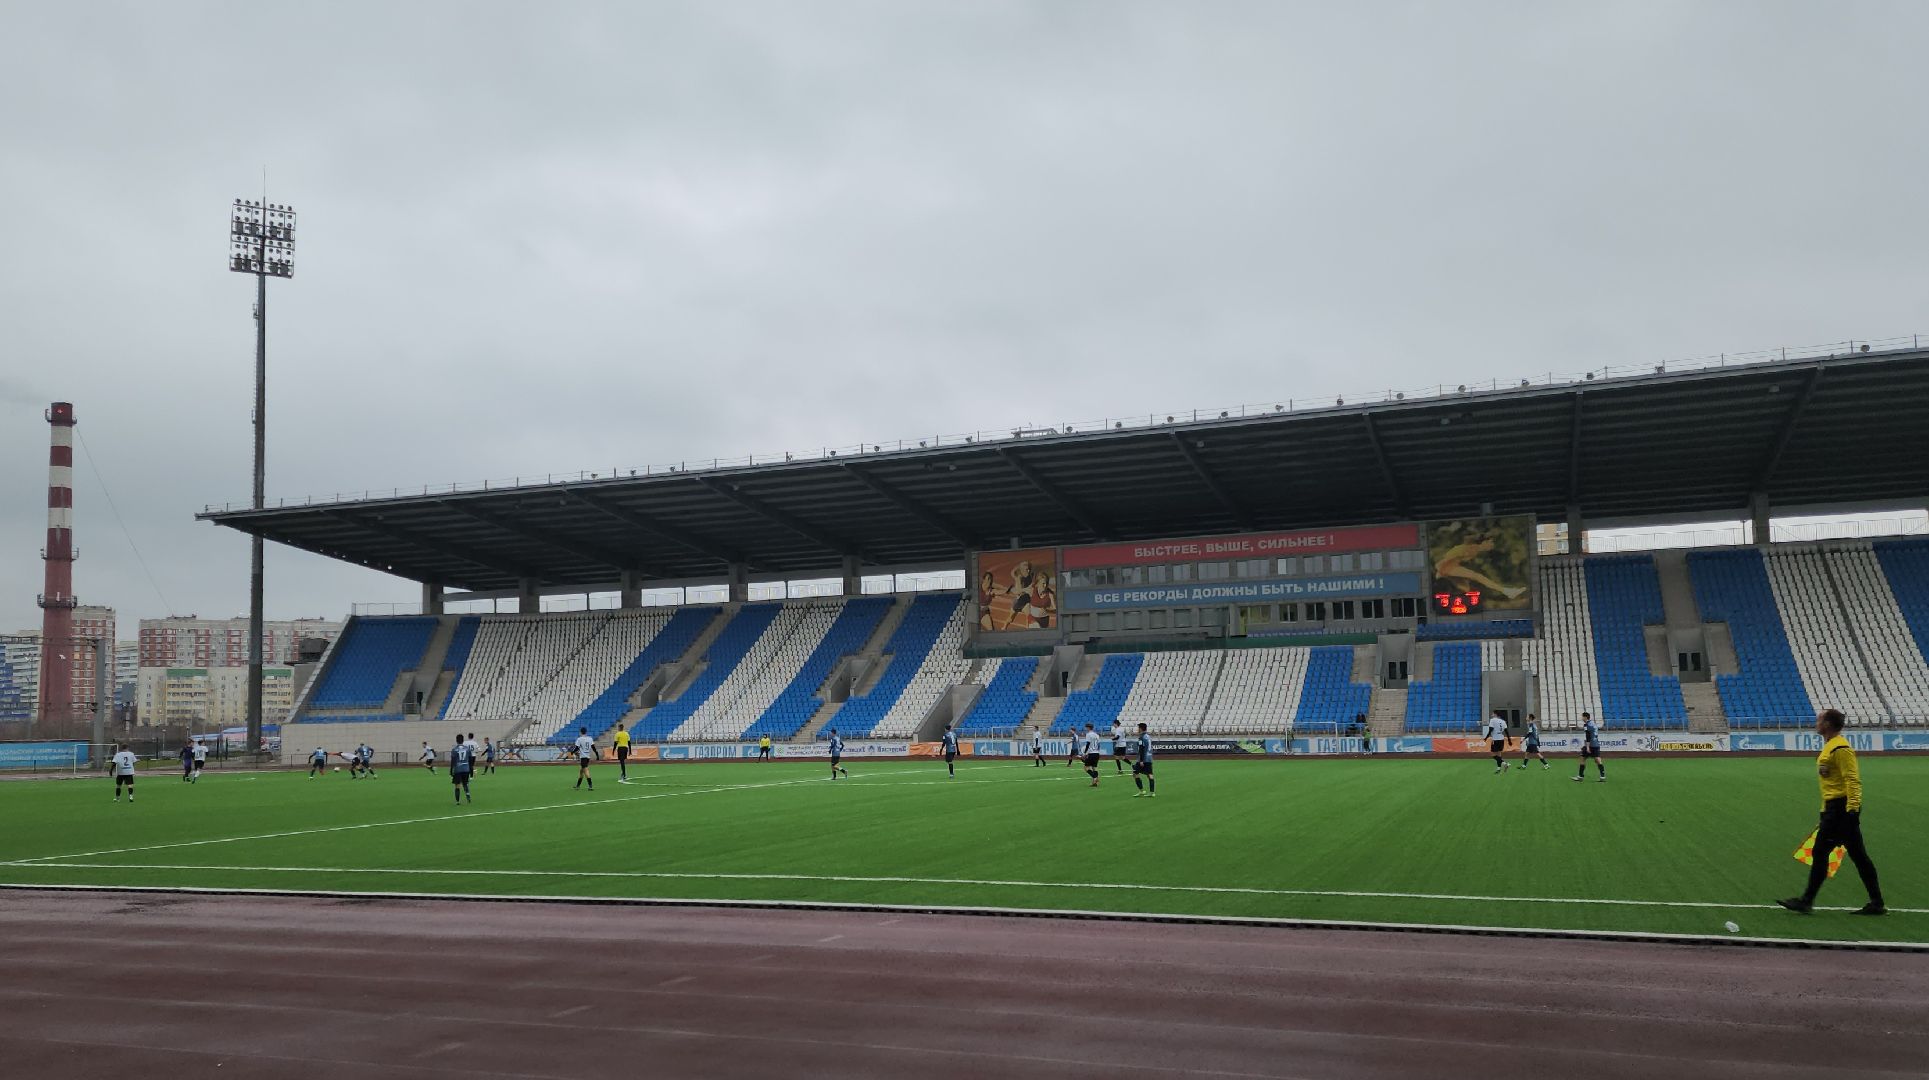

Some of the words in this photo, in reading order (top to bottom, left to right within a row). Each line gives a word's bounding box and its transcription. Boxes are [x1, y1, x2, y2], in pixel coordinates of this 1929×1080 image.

[1134, 544, 1201, 557] БЫСТРЕЕ,
[1206, 541, 1254, 554] ВЫШЕ,
[1258, 536, 1326, 549] СИЛЬНЕЕ
[1094, 593, 1120, 603] ВСЕ
[1123, 589, 1188, 602] РЕКОРДЫ
[1192, 586, 1257, 600] ДОЛЖНЫ
[1262, 584, 1303, 596] БЫТЬ
[1307, 579, 1375, 593] НАШИМИ
[1795, 734, 1873, 750] ГАЗОМ
[457, 750, 466, 761] 17
[694, 745, 737, 758] ГАЗПРОМ
[124, 757, 129, 767] 2
